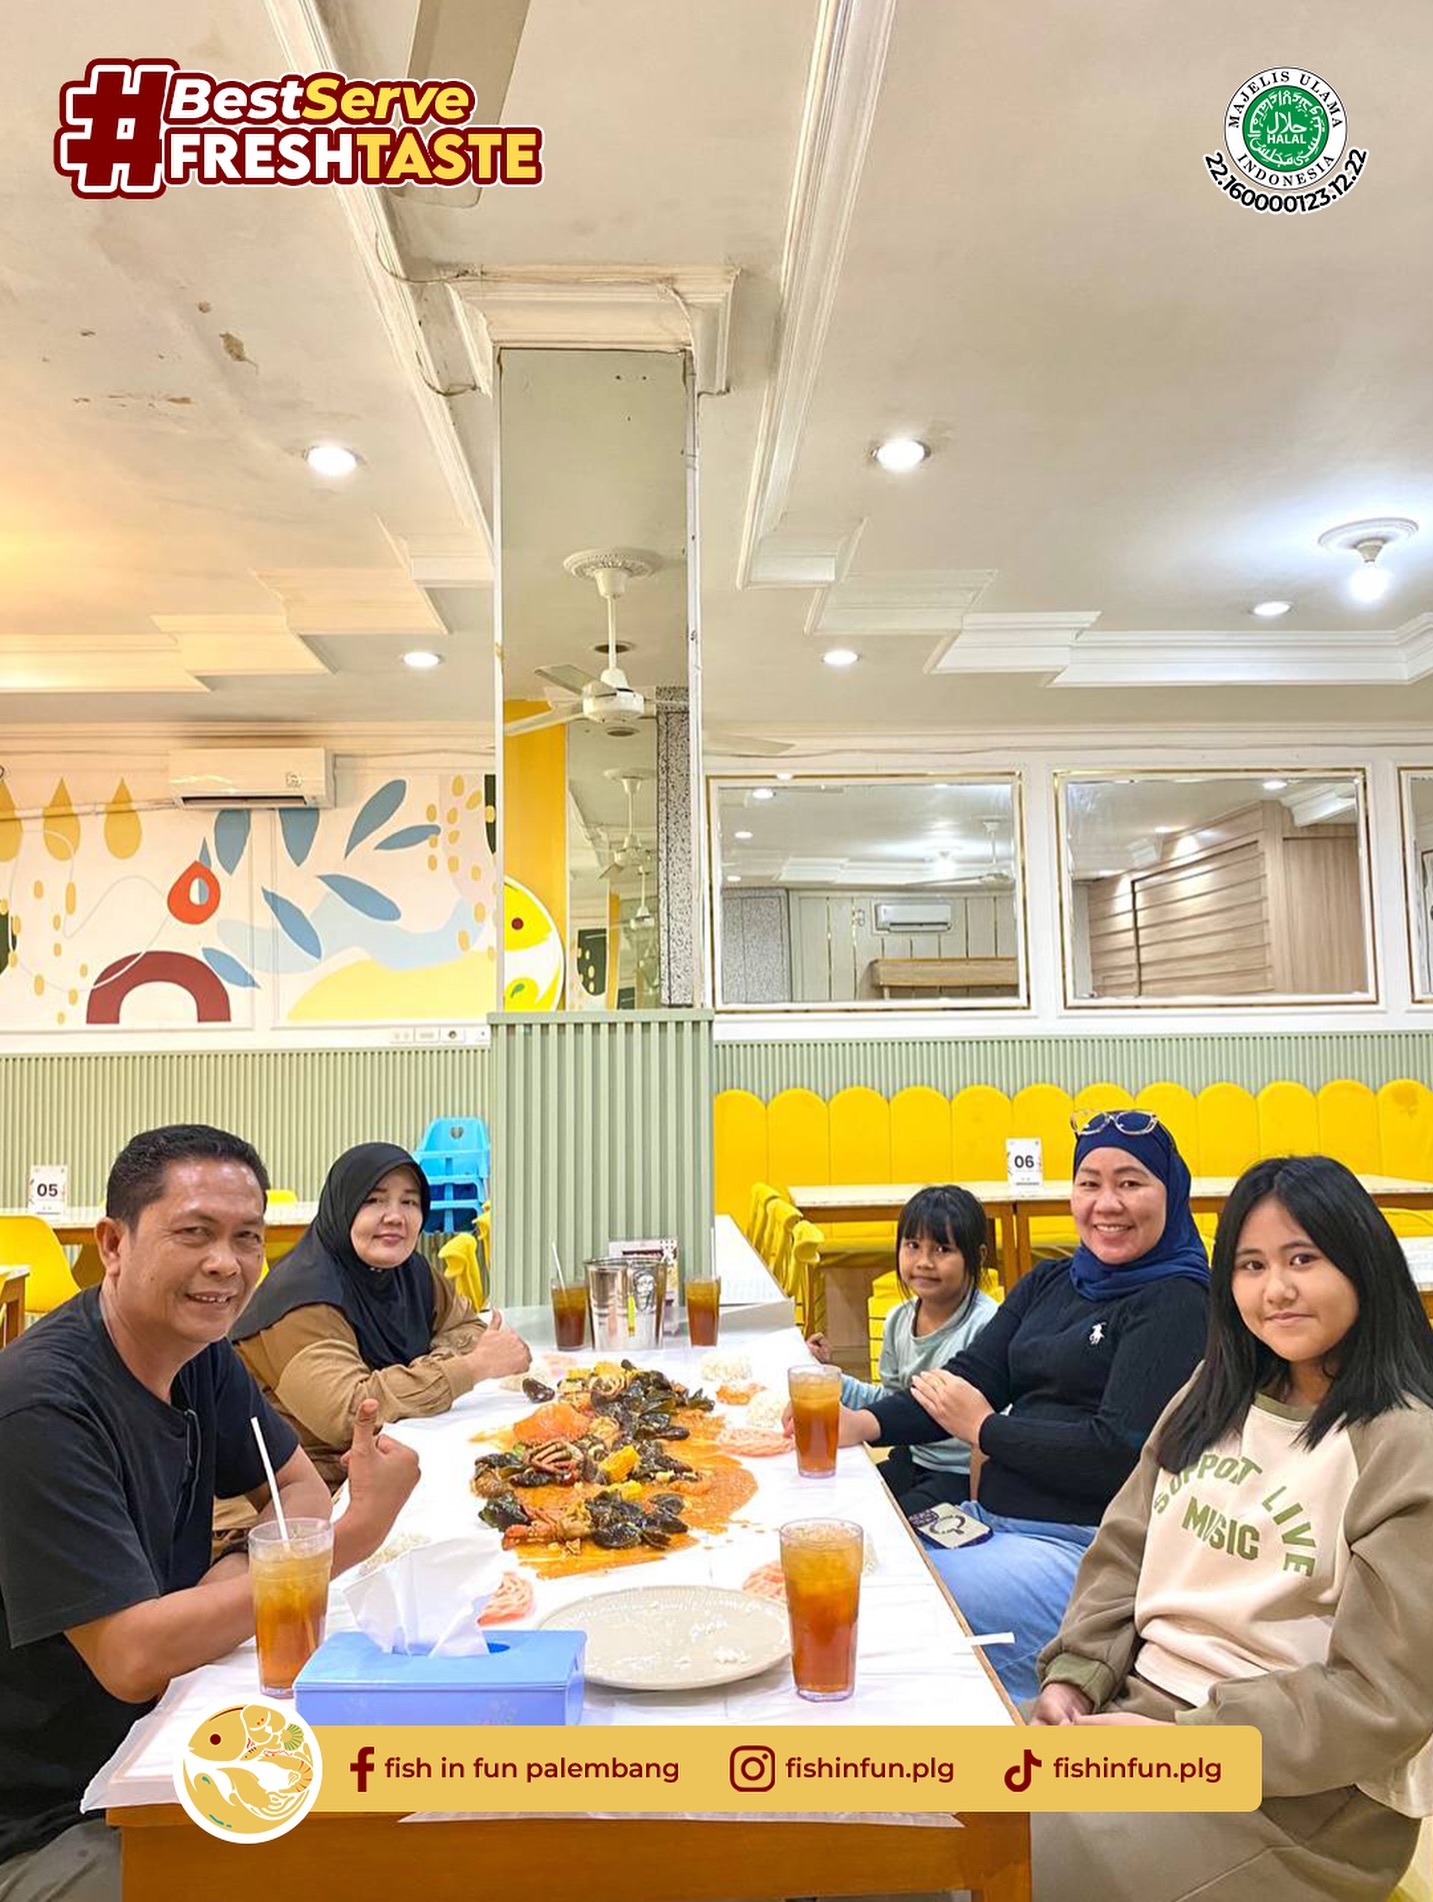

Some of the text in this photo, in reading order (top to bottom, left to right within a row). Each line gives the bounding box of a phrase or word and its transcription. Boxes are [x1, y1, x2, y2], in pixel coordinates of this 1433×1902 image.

[1014, 1154, 1035, 1169] 06
[36, 1183, 58, 1197] 05
[1261, 1485, 1317, 1578] LIVE
